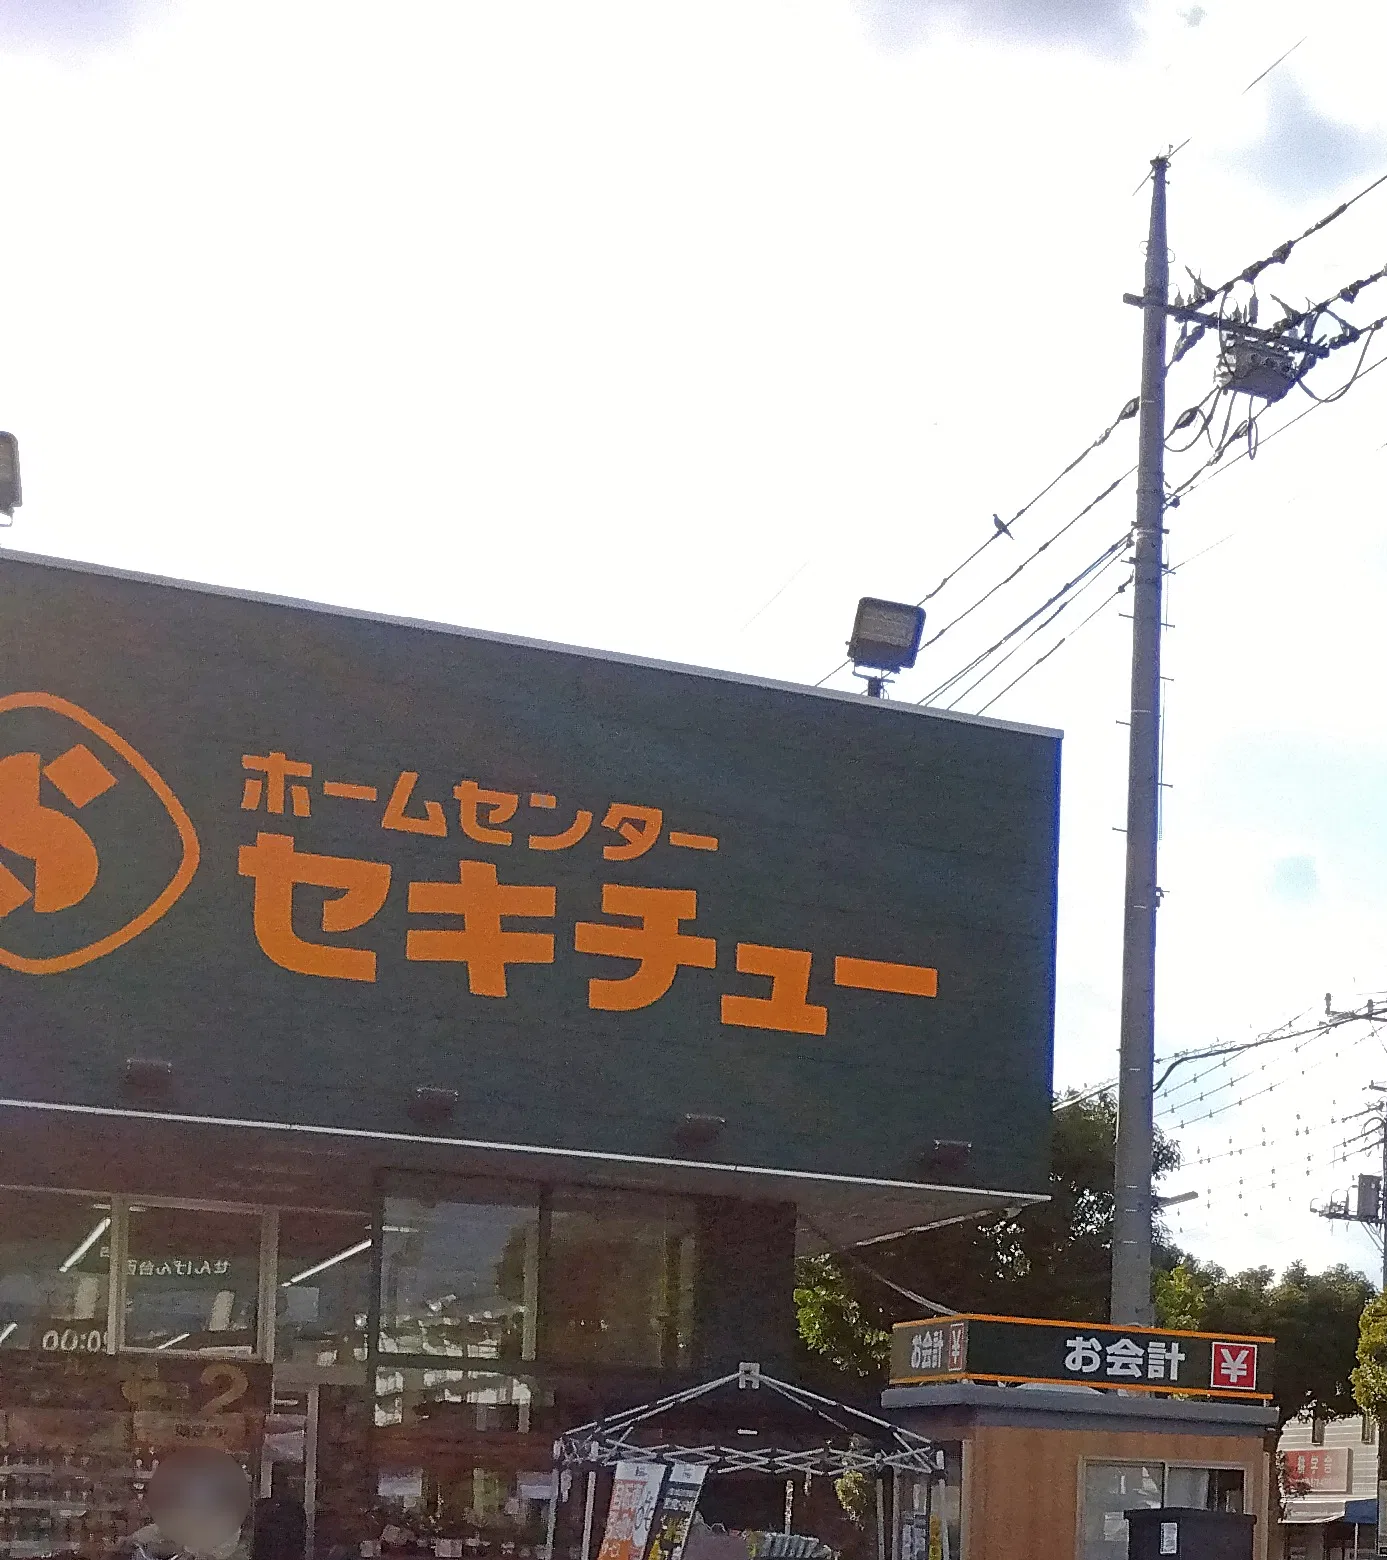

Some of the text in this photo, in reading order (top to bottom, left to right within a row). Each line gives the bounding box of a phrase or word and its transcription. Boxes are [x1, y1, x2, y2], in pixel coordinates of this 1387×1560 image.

[242, 752, 719, 861] ホームセンター
[238, 832, 938, 1036] セキチュー
[912, 1329, 943, 1369] お会計
[1065, 1336, 1185, 1381] お会計
